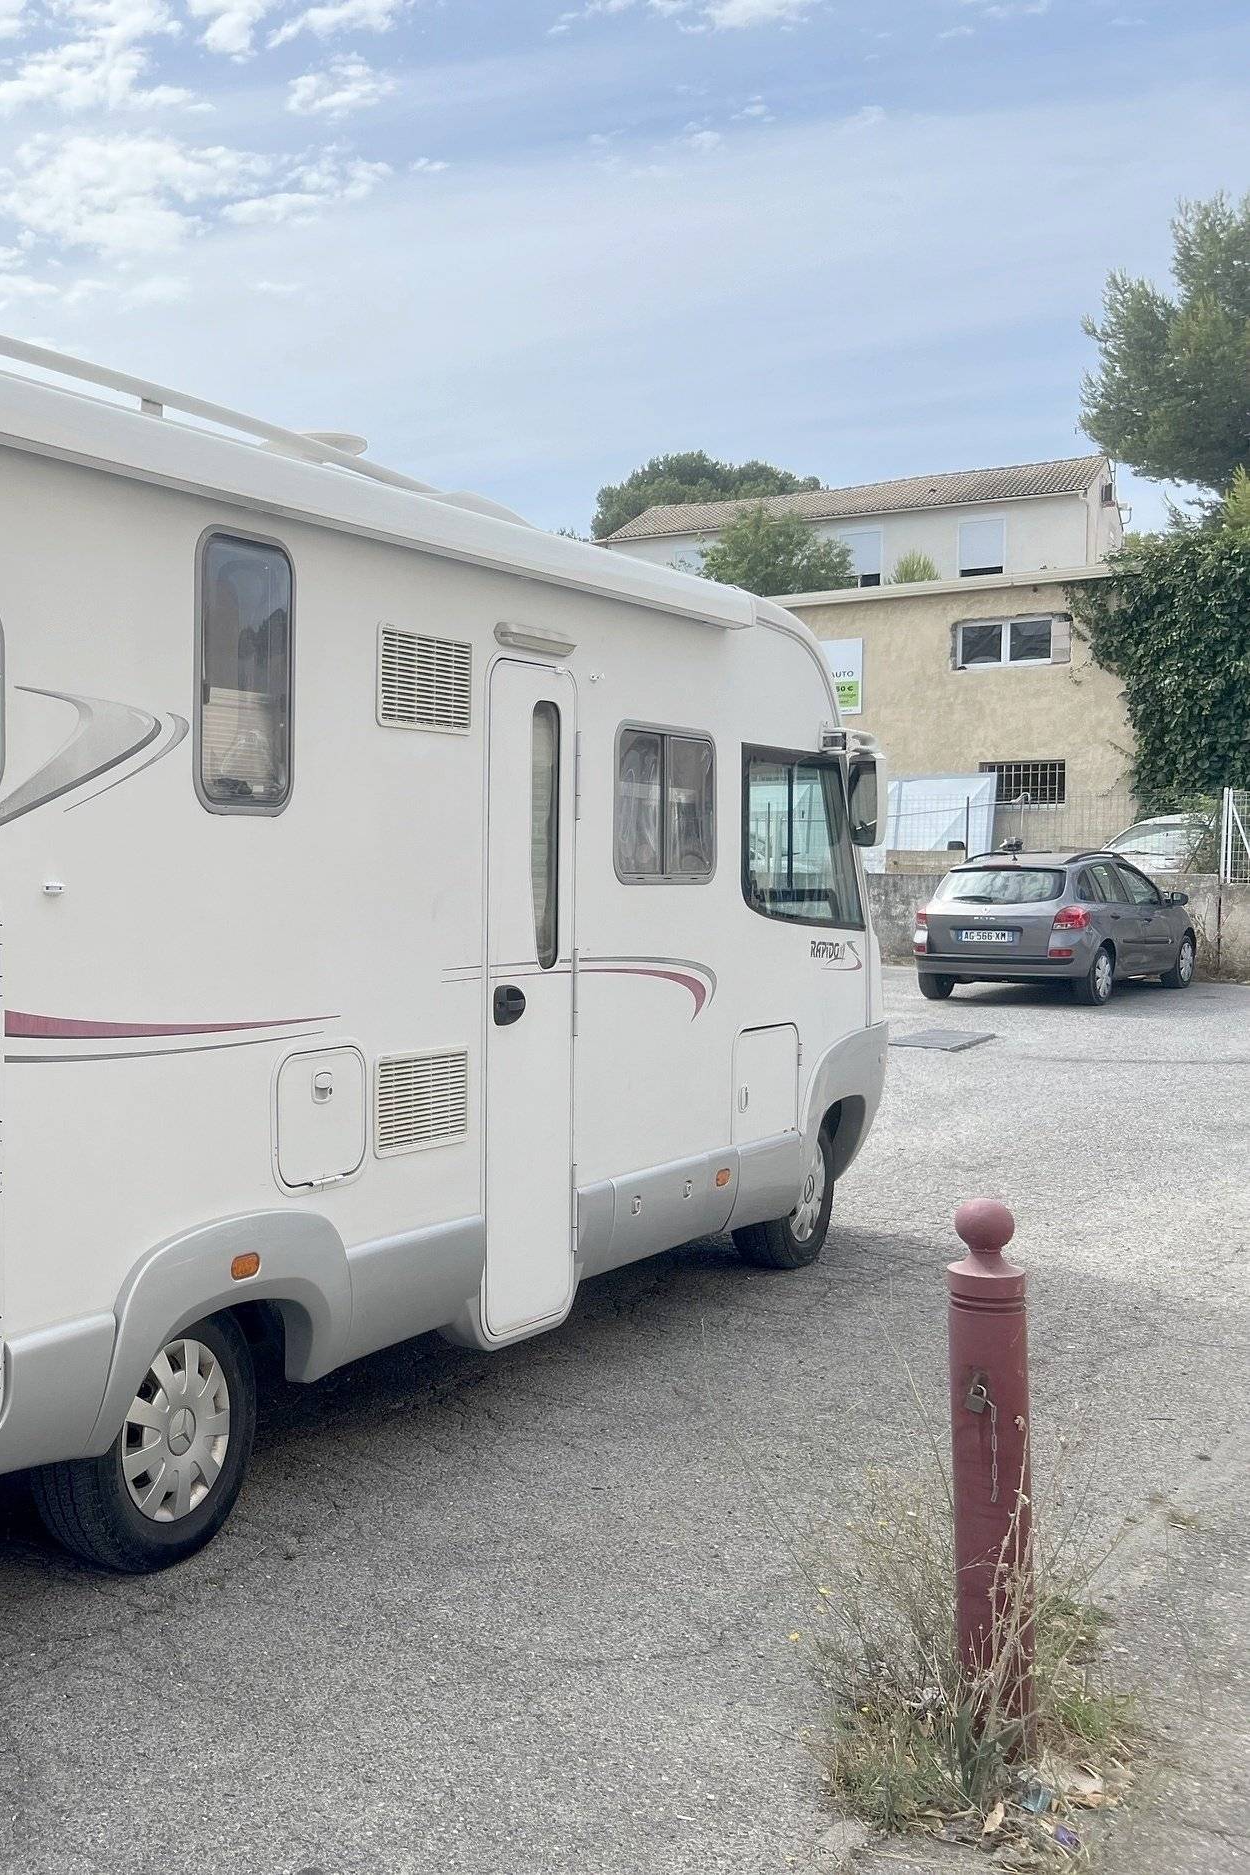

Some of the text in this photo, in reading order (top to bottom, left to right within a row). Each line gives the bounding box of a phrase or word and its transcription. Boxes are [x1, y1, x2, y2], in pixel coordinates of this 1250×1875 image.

[963, 931, 975, 941] AG
[976, 931, 993, 941] 566
[994, 932, 1006, 941] XM
